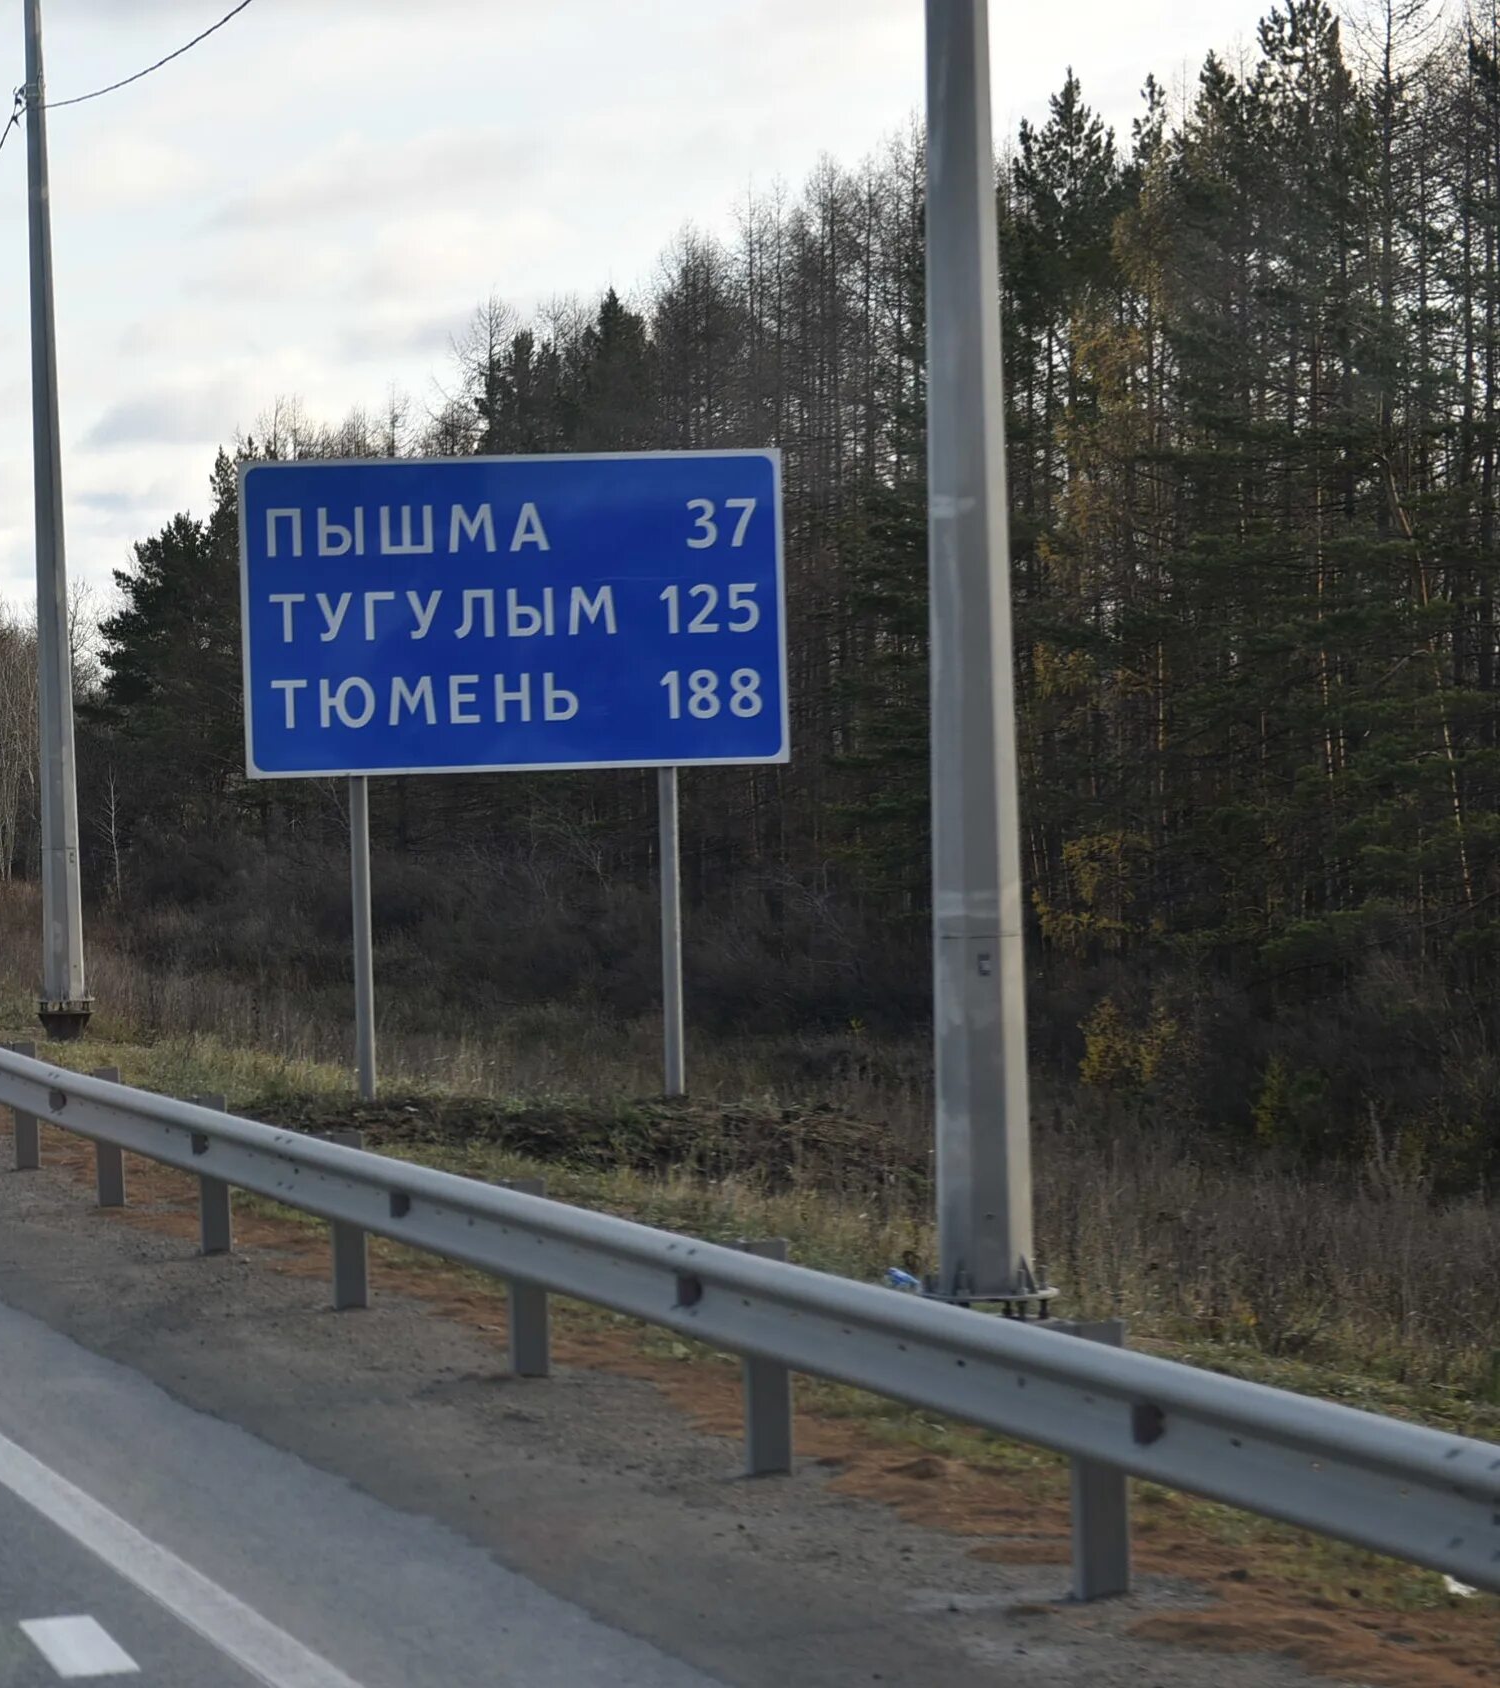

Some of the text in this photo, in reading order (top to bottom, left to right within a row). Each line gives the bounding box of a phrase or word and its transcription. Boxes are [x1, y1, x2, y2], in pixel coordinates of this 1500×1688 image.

[266, 497, 757, 557] ПЫШМА 37
[268, 583, 761, 642] ТУГУЛЫМ 125
[271, 668, 762, 729] ТЮМЕНЬ 188
